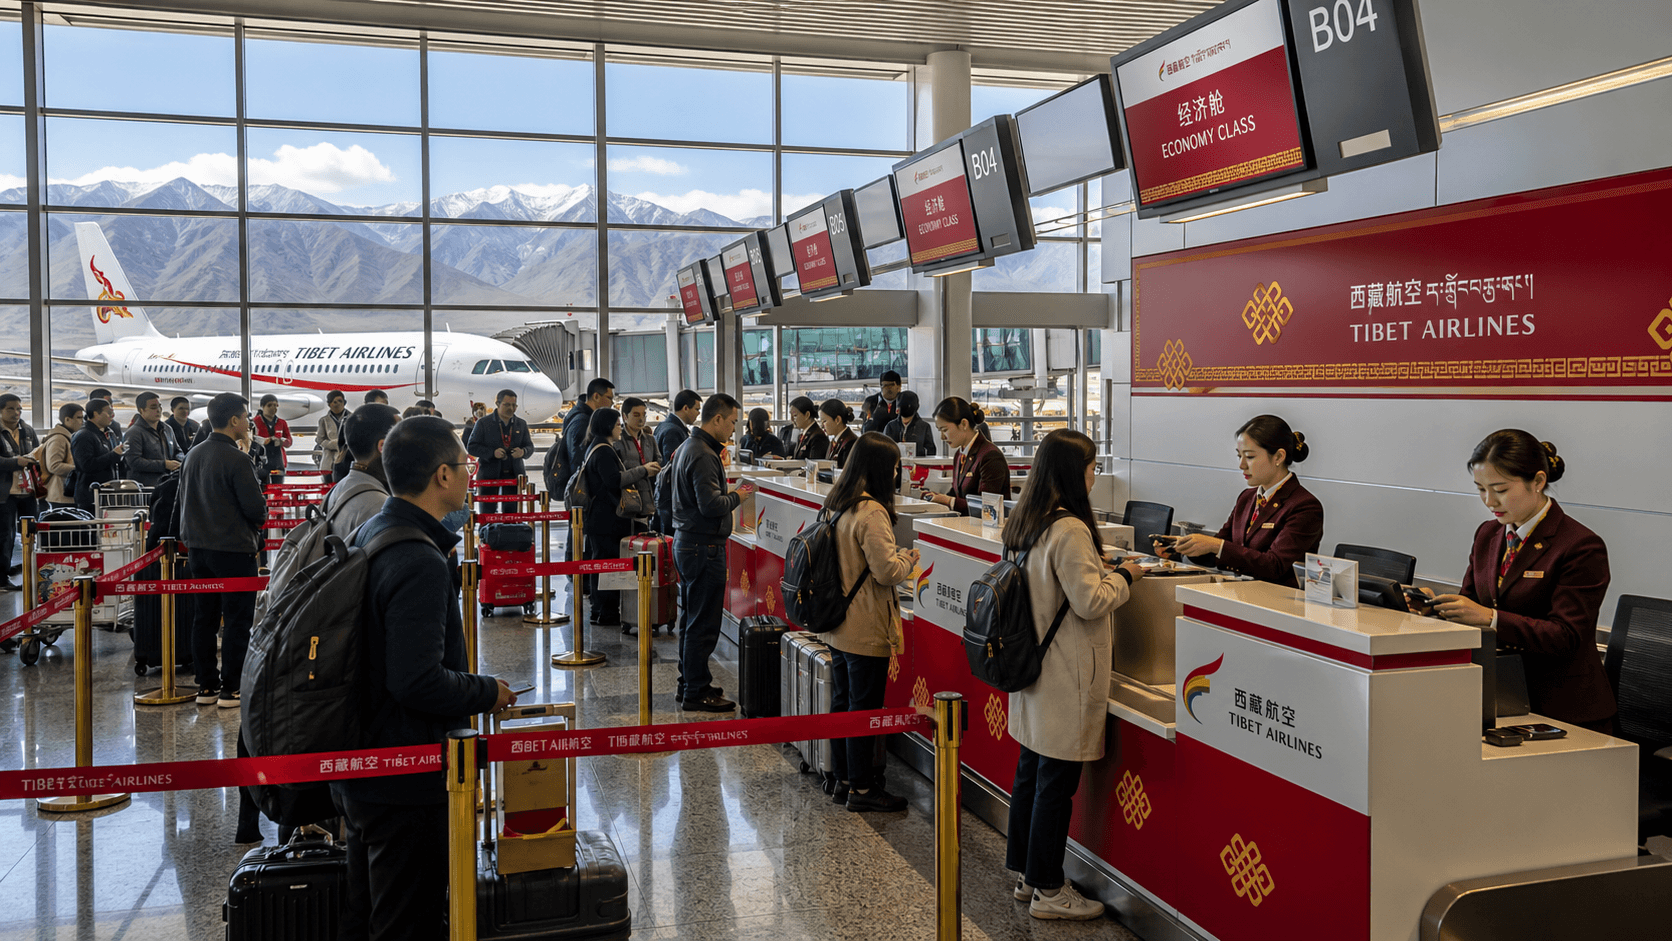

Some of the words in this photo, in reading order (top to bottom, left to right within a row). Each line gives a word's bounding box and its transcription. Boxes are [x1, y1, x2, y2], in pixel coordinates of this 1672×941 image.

[1308, 0, 1378, 53] B04
[1177, 87, 1225, 127] 经济舱
[1161, 128, 1214, 159] ECONOMY
[1217, 114, 1256, 141] CLASS
[971, 146, 998, 180] B04
[1350, 278, 1422, 315] 西藏航空
[1350, 320, 1413, 343] TIBET
[1421, 313, 1536, 340] AIRLINES
[294, 346, 340, 359] TIBET
[339, 345, 416, 359] AIRLINES
[1234, 687, 1296, 729] 西藏航空
[1228, 711, 1263, 736] TIBET
[1265, 726, 1323, 760] AIRLINES
[320, 756, 379, 774] 西藏航空
